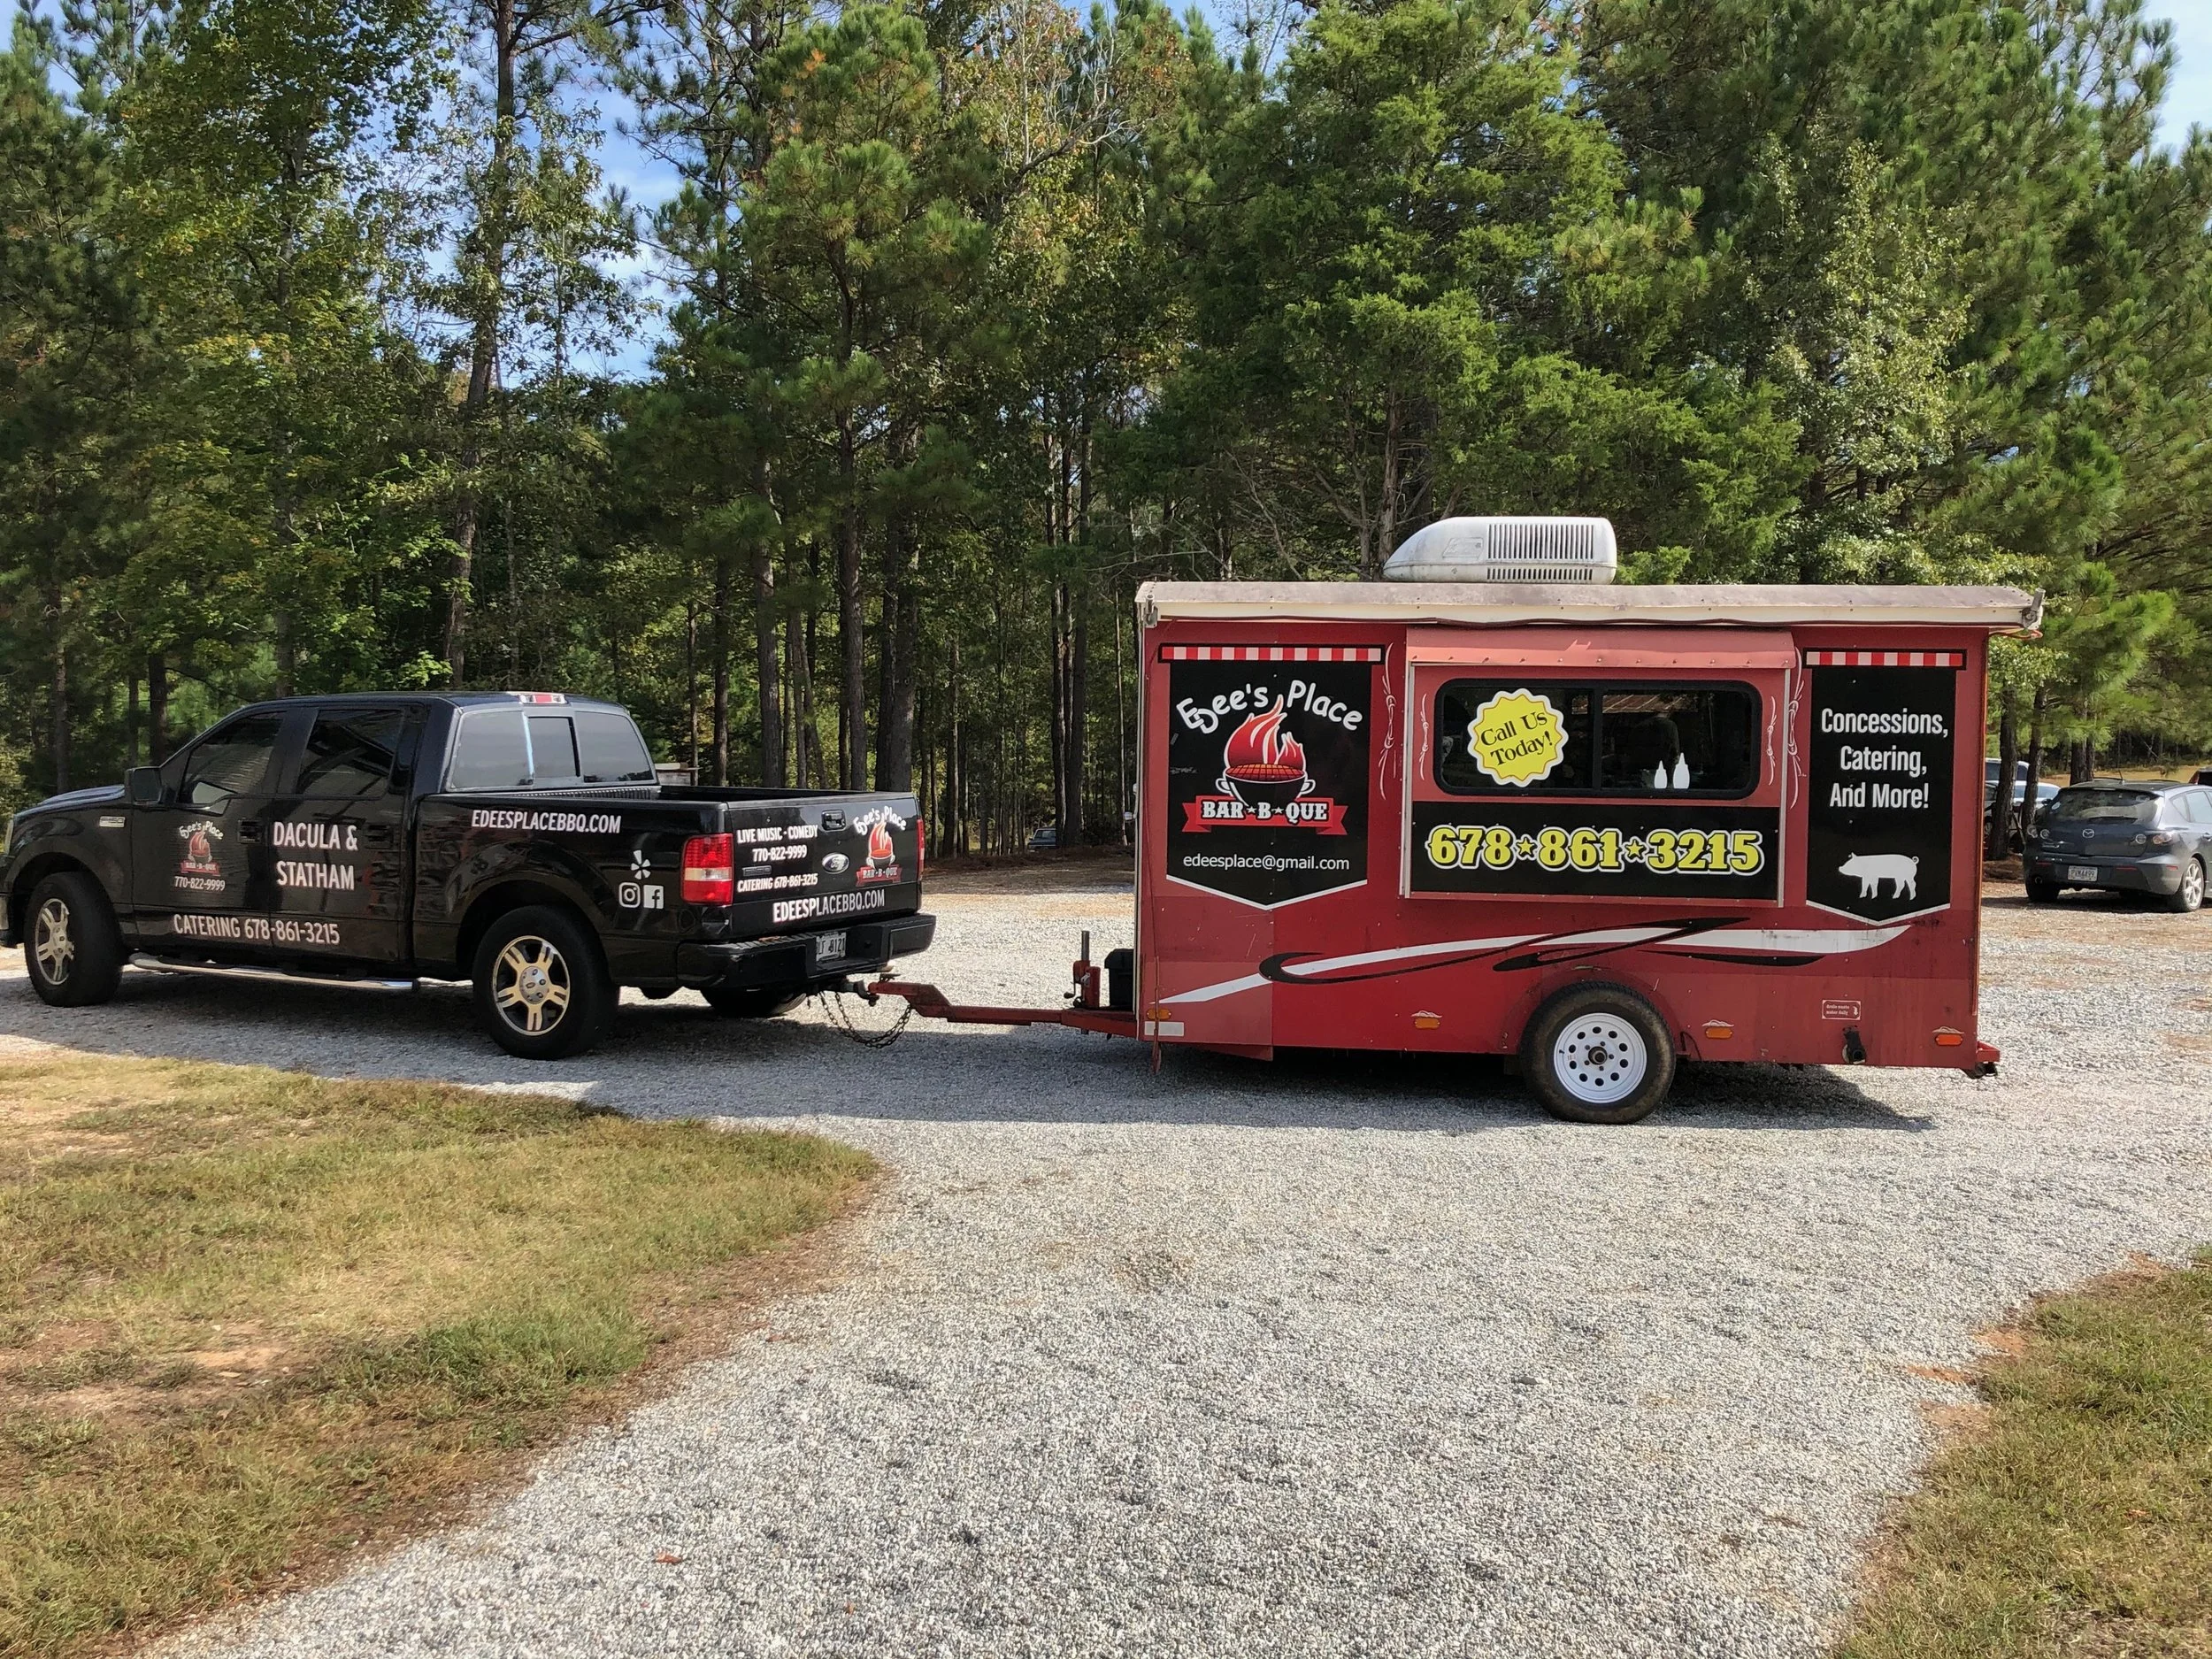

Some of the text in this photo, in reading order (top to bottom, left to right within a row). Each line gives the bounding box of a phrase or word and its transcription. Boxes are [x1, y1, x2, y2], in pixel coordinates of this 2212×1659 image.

[1286, 680, 1363, 730] Place
[1479, 710, 1548, 747] Call Us
[1821, 708, 1948, 738] Concessions,
[1490, 731, 1553, 766] Today!
[1840, 745, 1927, 778] Catering,
[1830, 782, 1929, 809] And More!
[205, 820, 224, 840] Place
[472, 809, 621, 833] EDEESPLACEBBQ.COM
[884, 805, 907, 831] Place
[273, 821, 358, 851] DACULA &
[736, 825, 818, 844] LIVE MUSIC COMEDY
[752, 844, 808, 863] 770-822-9999
[1183, 853, 1350, 872] edeesplace@gmail.com
[174, 876, 226, 891] 770-822-9999
[276, 860, 355, 891] STATHAM
[737, 872, 818, 893] CATERING 678-861-3215
[772, 888, 885, 924] EDEESPLACEBBQ.COM
[173, 914, 341, 945] CATERING 678-861-3215
